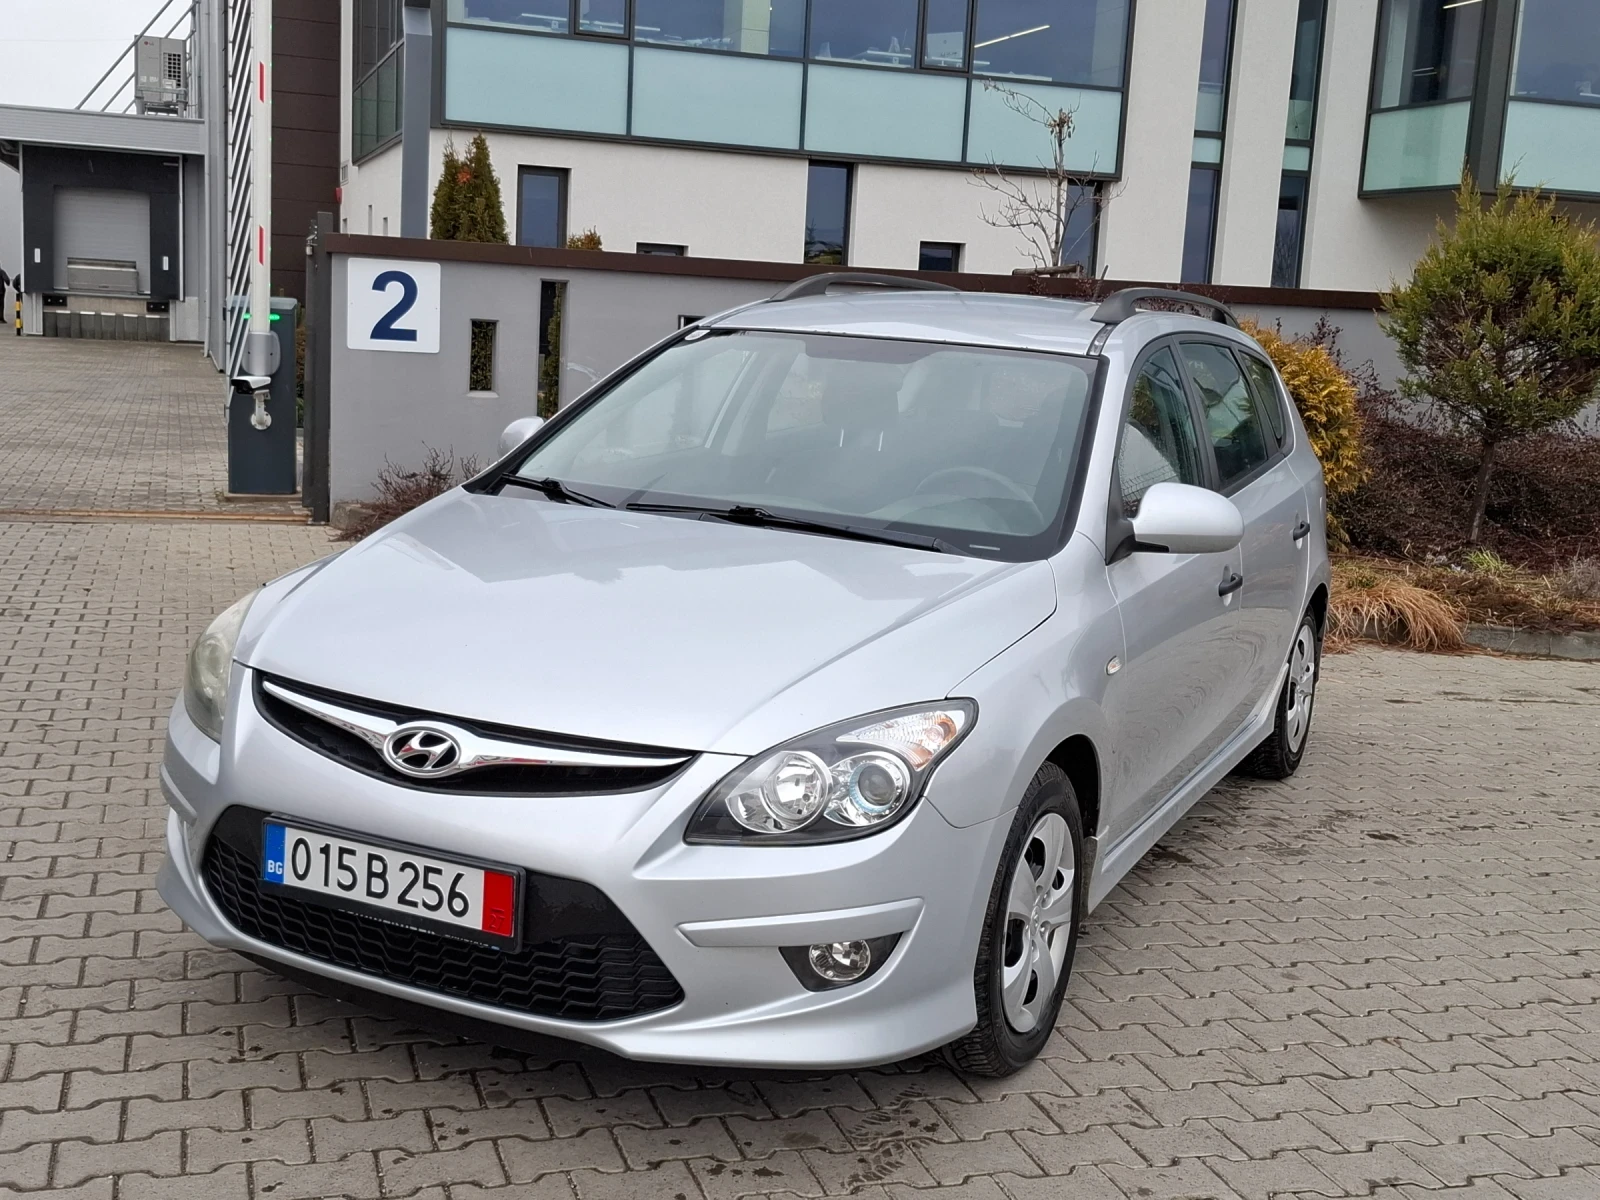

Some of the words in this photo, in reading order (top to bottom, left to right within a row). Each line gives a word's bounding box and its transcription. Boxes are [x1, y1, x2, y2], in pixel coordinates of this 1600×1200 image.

[370, 270, 418, 342] 2
[267, 859, 283, 875] BG
[291, 837, 470, 918] 015B256
